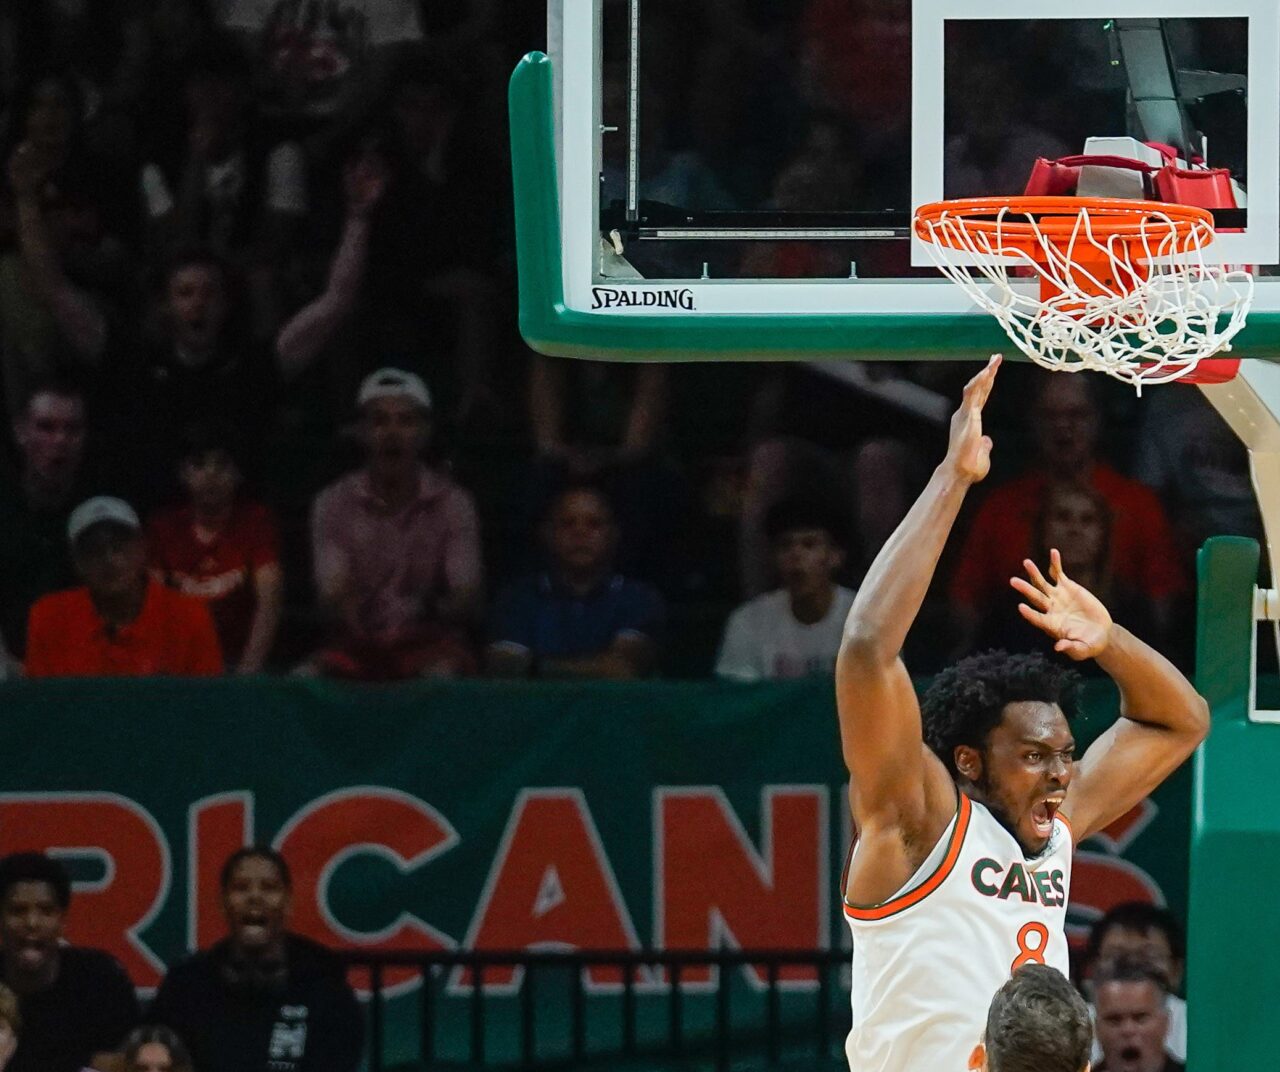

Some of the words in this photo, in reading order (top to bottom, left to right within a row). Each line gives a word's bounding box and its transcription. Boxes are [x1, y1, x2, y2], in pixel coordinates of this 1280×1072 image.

[591, 287, 694, 311] SPALDING
[0, 784, 1170, 1002] RICAN
[1011, 921, 1049, 973] 8
